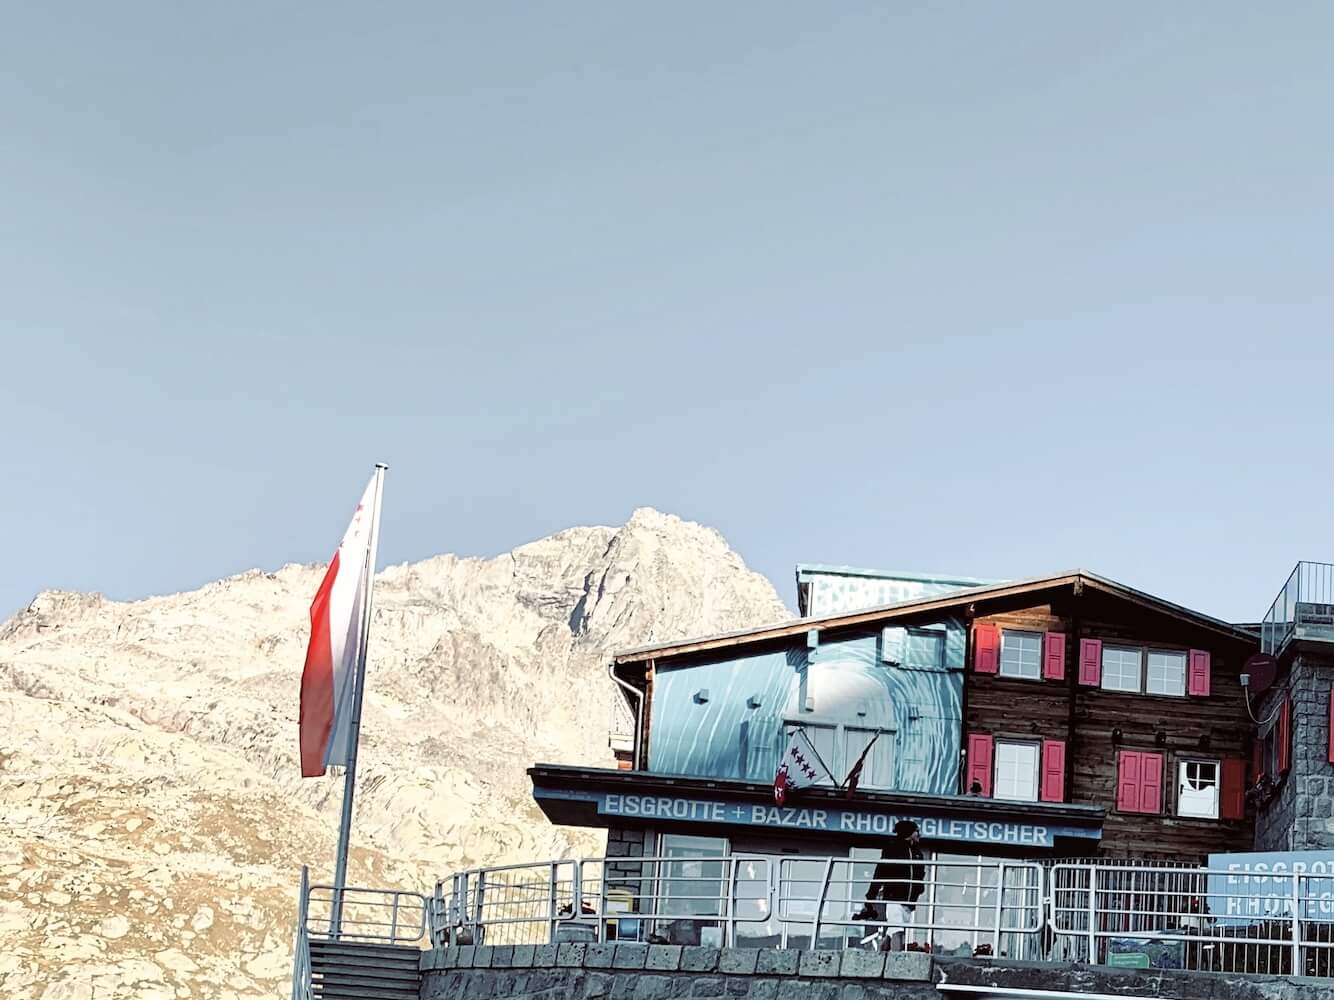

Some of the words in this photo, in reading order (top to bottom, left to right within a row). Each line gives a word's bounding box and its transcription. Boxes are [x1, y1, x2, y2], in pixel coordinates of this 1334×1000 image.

[604, 794, 725, 821] EISGROTTE
[751, 805, 828, 829] BAZAR
[840, 811, 1048, 844] RHONGLETSCHER
